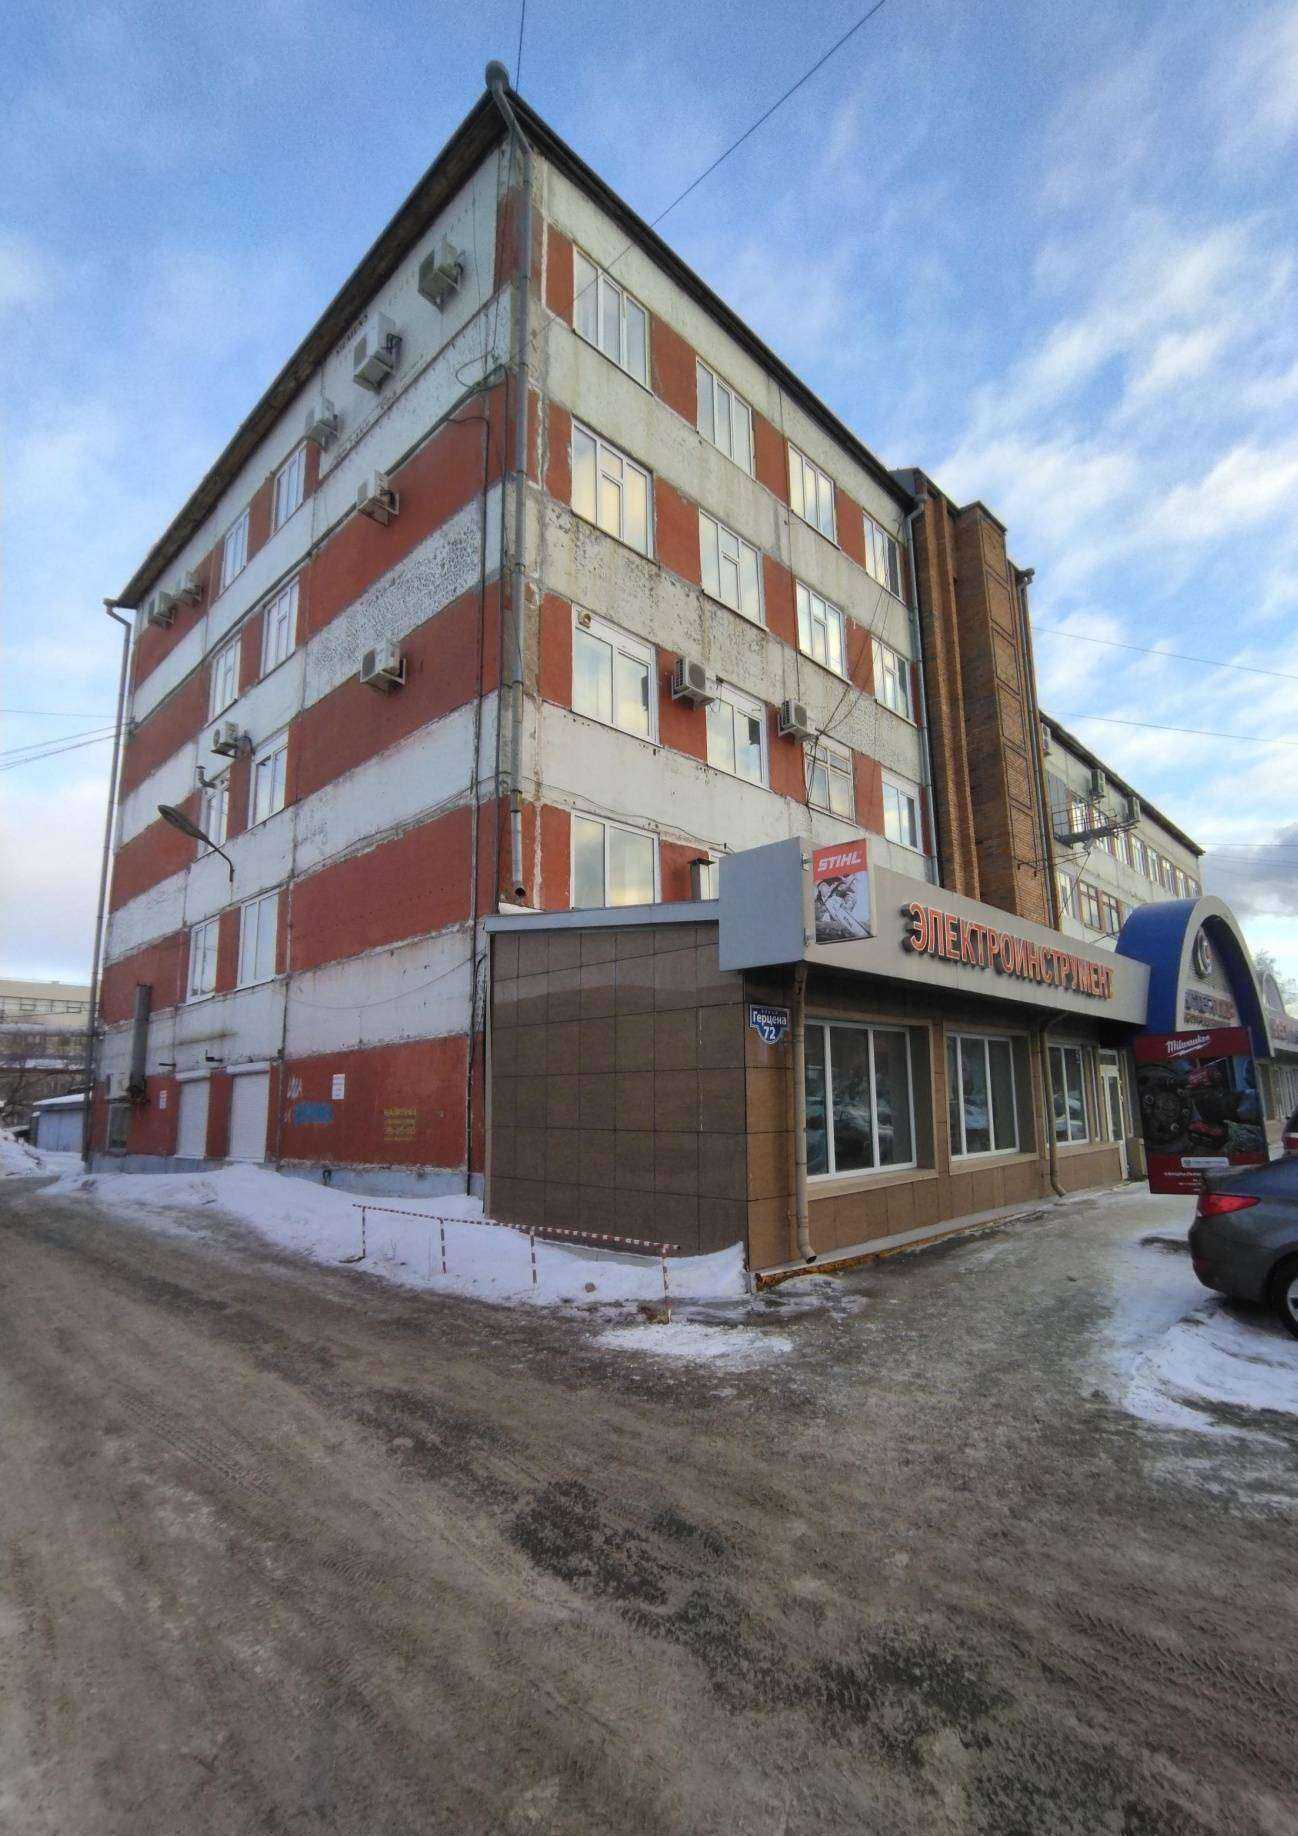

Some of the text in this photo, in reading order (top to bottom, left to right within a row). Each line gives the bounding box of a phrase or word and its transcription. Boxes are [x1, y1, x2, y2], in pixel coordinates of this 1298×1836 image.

[817, 850, 862, 872] STIHL
[908, 902, 1114, 999] ЭЛЕКТРОИНСТРУМЕНТ
[752, 1010, 787, 1026] Герцена
[763, 1026, 776, 1040] 72
[1165, 1034, 1210, 1054] Milwaukee
